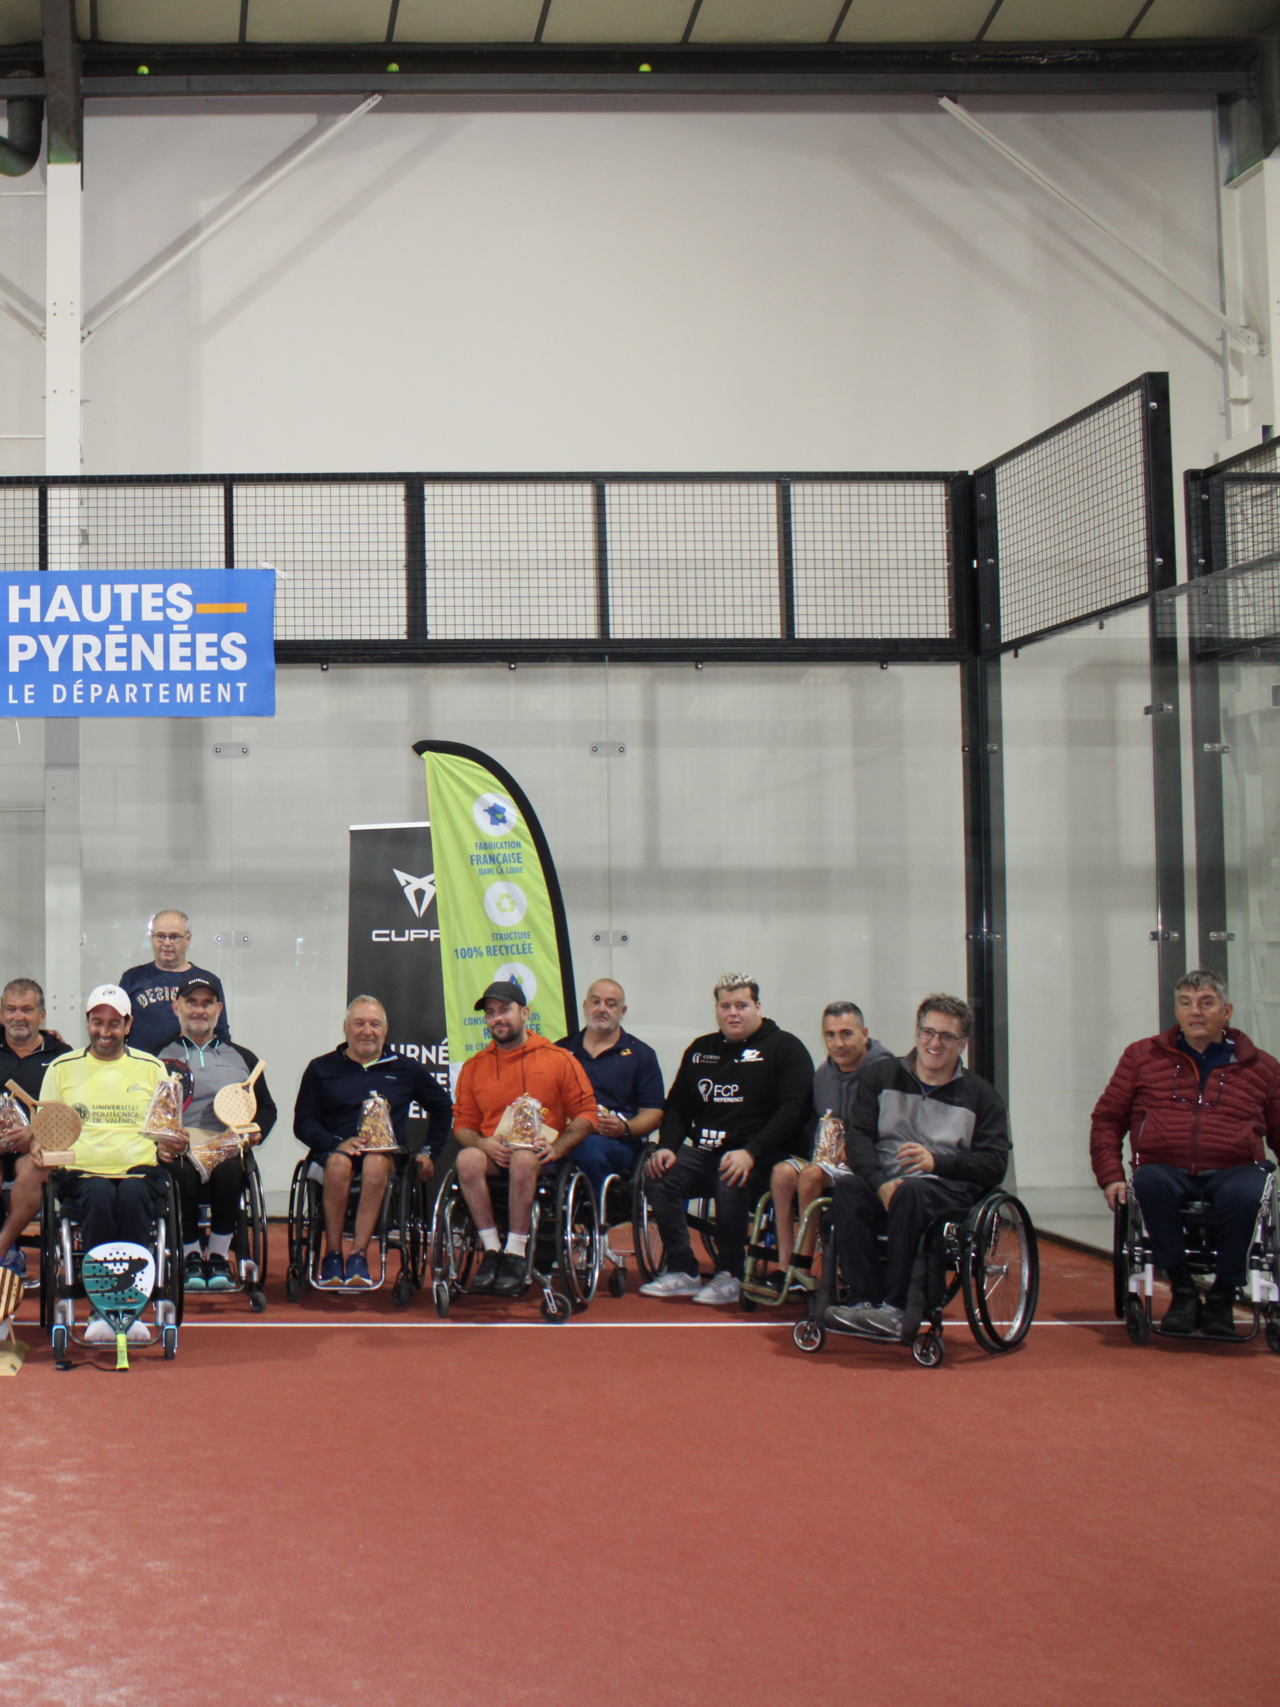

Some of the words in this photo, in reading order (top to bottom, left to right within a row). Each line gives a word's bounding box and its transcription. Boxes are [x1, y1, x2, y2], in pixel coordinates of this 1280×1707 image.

[8, 624, 247, 672] PYRÉNÉES
[8, 684, 35, 704] LE
[52, 679, 247, 704] DÉPARTEMENT
[475, 841, 522, 850] FABRICATION
[470, 852, 523, 867] FRANÇAISE
[478, 868, 494, 876] DANS
[496, 867, 505, 875] LA
[506, 866, 525, 874] LOIRE
[491, 931, 531, 941] STRUCTURE
[454, 946, 484, 959] 100%
[486, 940, 534, 957] RECYCLÉE
[465, 1043, 474, 1052] DE
[714, 1084, 739, 1097] FCP
